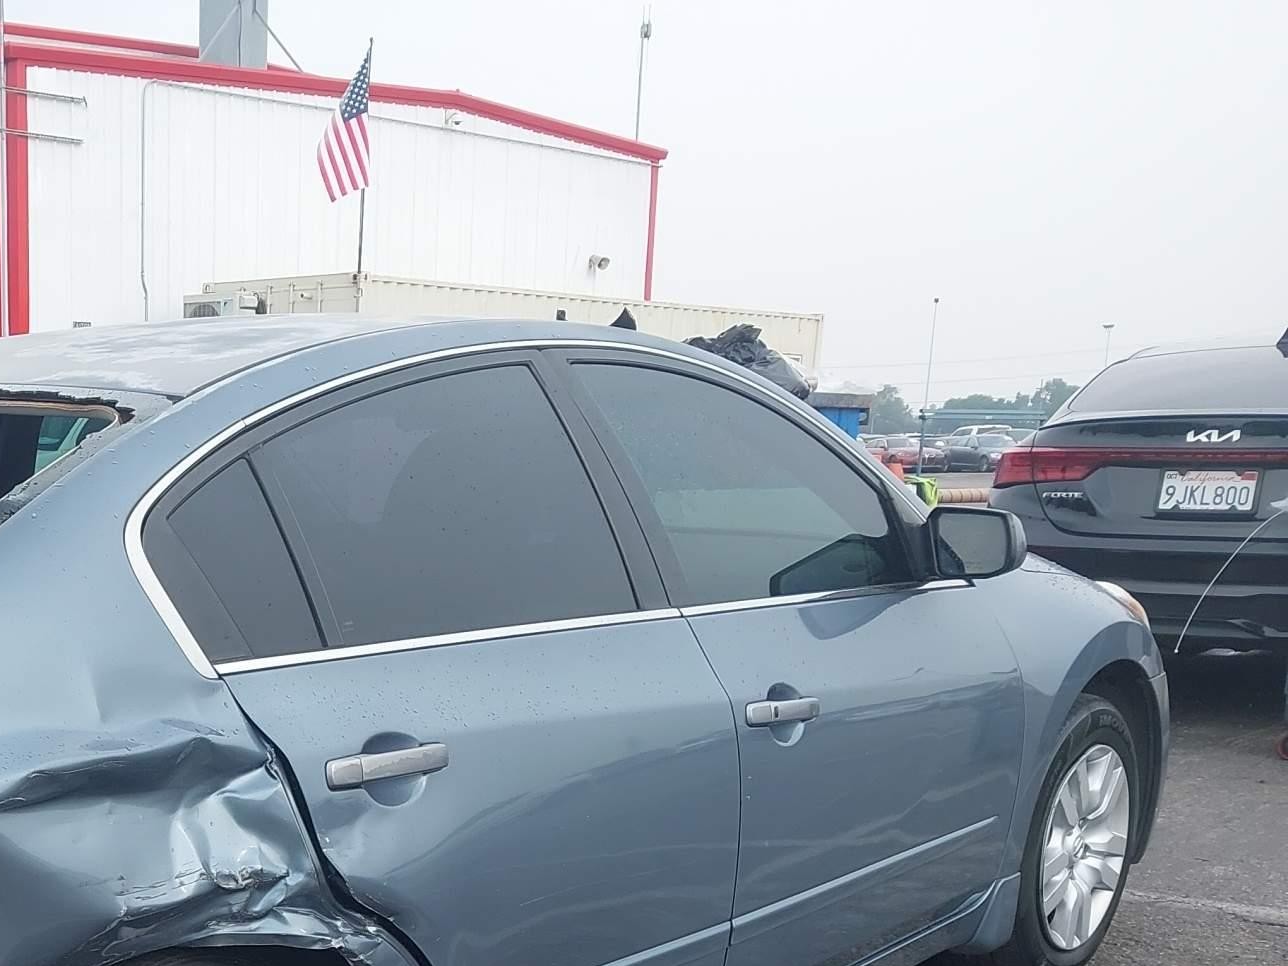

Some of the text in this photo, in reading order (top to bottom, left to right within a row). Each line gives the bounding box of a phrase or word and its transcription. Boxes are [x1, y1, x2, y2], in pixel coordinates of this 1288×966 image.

[1186, 429, 1242, 443] KIA
[1042, 491, 1084, 499] FORTE
[1162, 484, 1251, 506] 9JKL800
